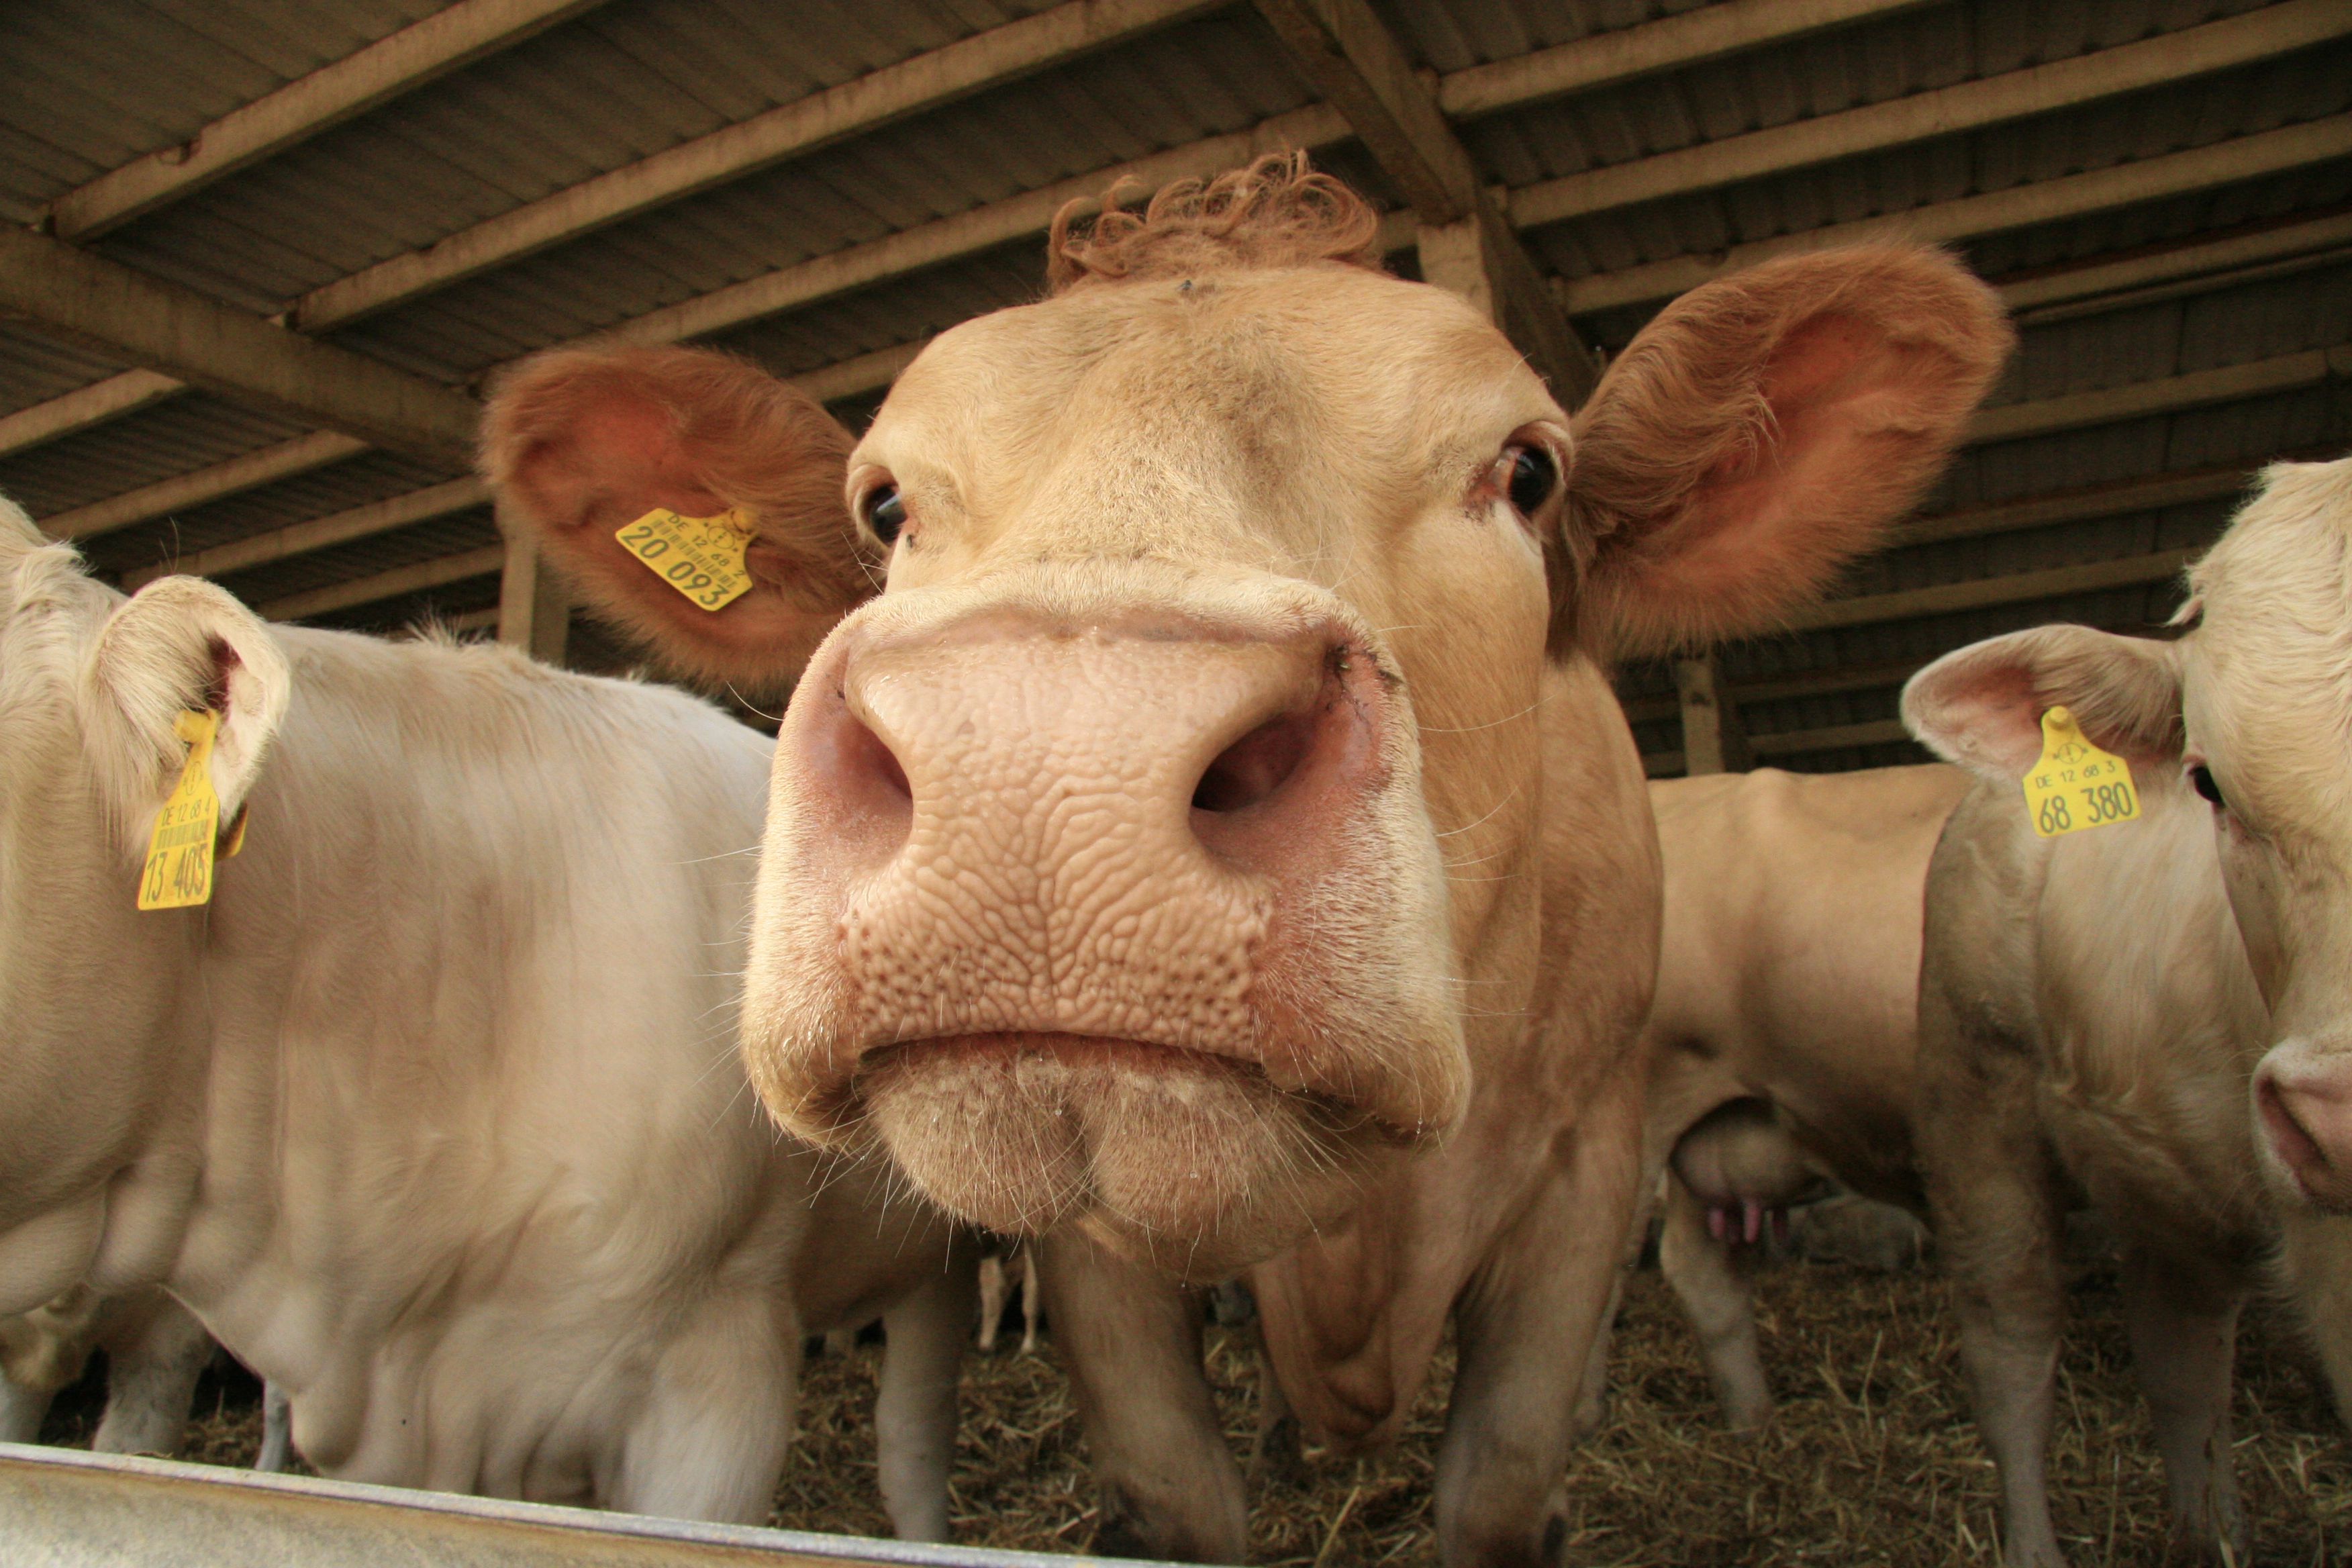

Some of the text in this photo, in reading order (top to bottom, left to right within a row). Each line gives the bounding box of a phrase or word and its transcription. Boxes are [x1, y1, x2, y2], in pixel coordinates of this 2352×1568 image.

[621, 526, 730, 605] 20 093
[667, 513, 688, 532] DE
[692, 536, 707, 548] 12
[711, 553, 730, 567] 68
[2035, 760, 2116, 789] DE 12 68 3
[162, 806, 175, 826] DE
[179, 803, 188, 822] 12
[190, 799, 201, 819] 68
[2039, 782, 2133, 834] 68 380
[146, 843, 209, 902] 13 405
